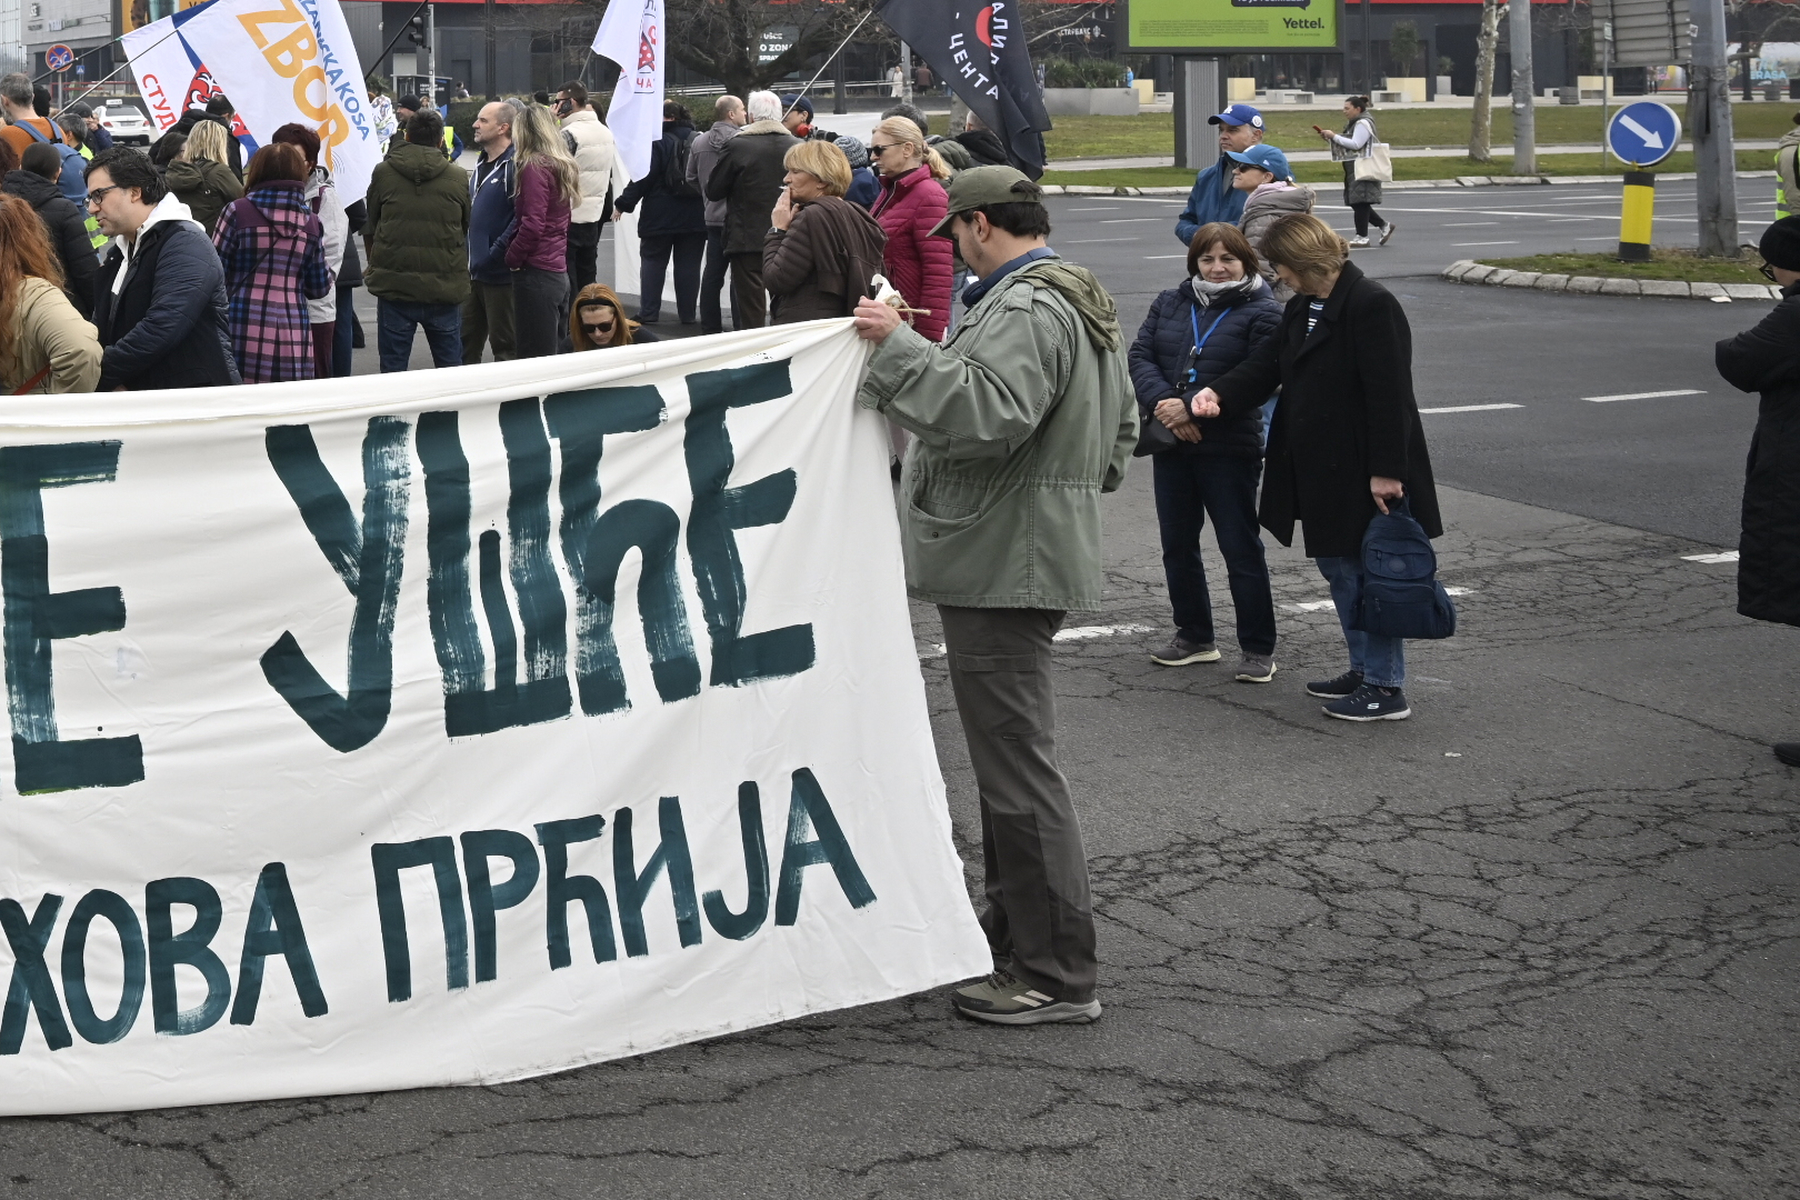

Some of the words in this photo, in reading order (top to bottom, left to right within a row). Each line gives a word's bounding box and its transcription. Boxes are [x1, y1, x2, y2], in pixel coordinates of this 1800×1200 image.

[335, 82, 370, 141] KOSA
[260, 358, 815, 753] УШЋЕ
[372, 766, 878, 1005] ПРЋИЈА
